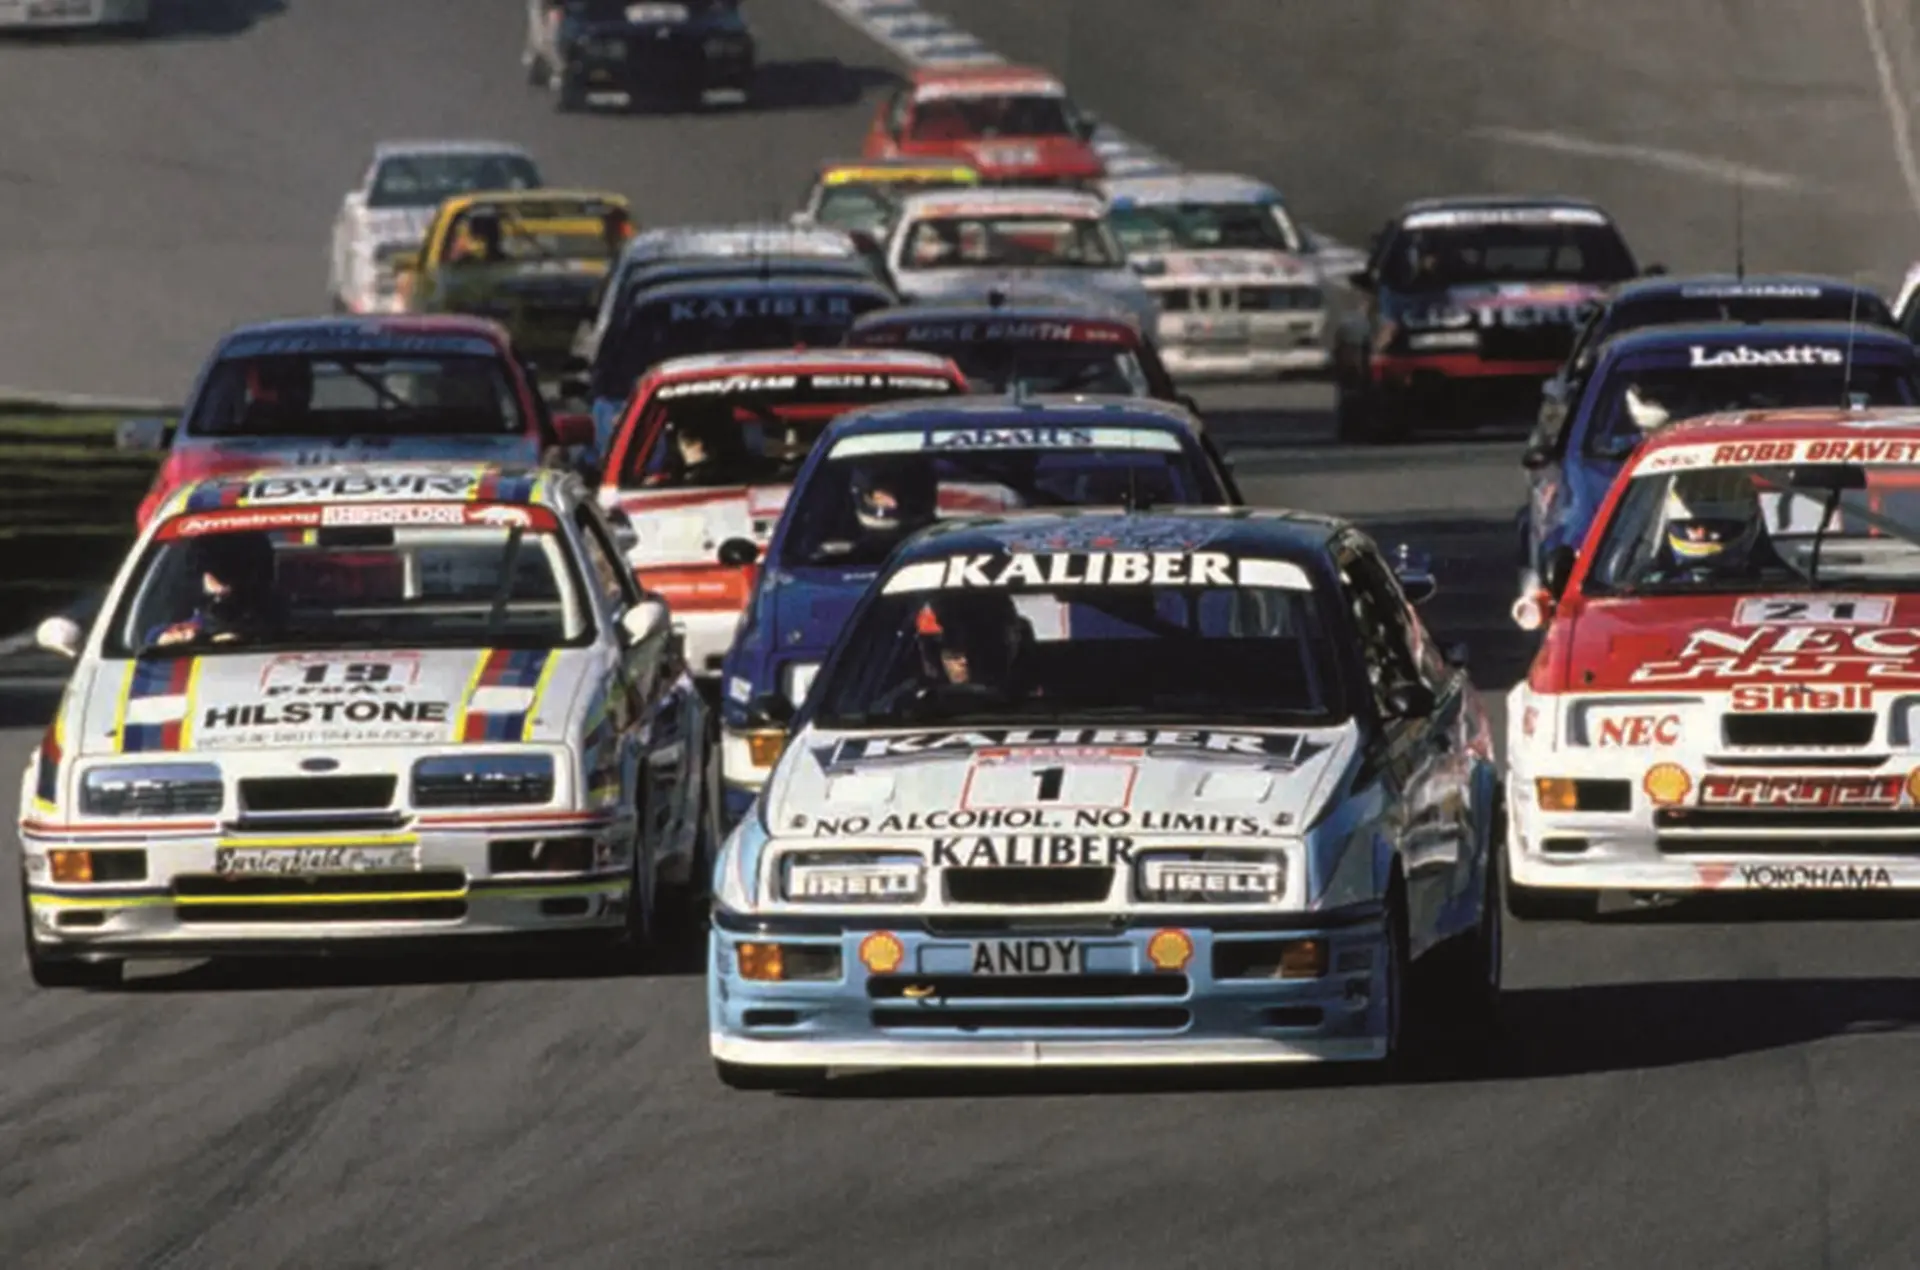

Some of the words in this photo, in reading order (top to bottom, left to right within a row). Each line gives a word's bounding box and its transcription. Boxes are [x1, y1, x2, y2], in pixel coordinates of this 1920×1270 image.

[671, 299, 850, 321] KALIBER
[1689, 345, 1842, 367] Labatt's
[1713, 443, 1796, 463] ROBB
[945, 552, 1233, 587] KALIBER
[1764, 602, 1857, 621] 21
[301, 663, 392, 684] 19
[1730, 684, 1874, 710] Shell
[204, 701, 449, 728] HILSTONE
[864, 729, 1268, 756] KALIBER
[1598, 714, 1681, 747] NEC
[1031, 767, 1065, 801] 1
[813, 815, 870, 838] NO
[878, 808, 1062, 832] ALCOHOL.
[1075, 807, 1130, 829] NO
[1140, 810, 1270, 836] LIMITS.
[931, 836, 1135, 867] KALIBER
[1740, 864, 1893, 889] YOKOHAMA
[972, 941, 1077, 974] ANDY
